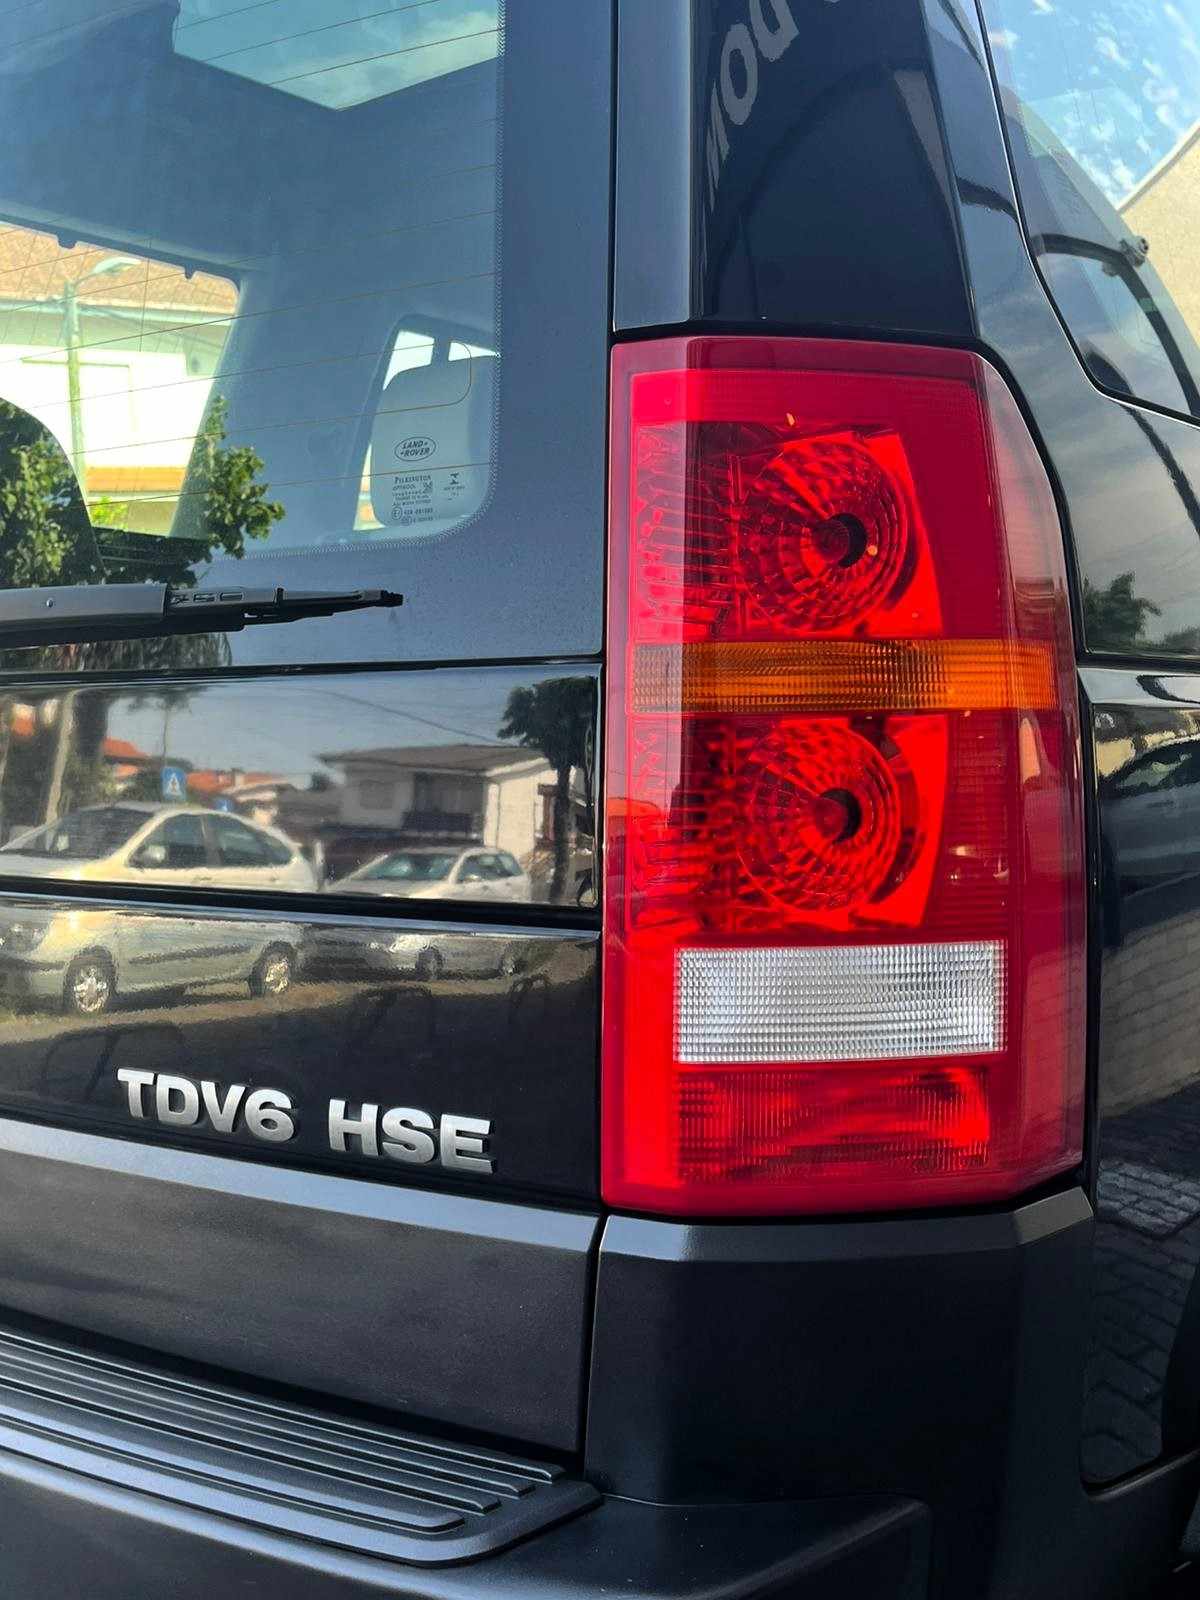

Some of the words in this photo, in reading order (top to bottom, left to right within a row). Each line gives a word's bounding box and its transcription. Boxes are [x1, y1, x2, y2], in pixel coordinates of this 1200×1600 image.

[403, 440, 424, 449] LAND
[403, 447, 430, 457] ROVER
[117, 1068, 296, 1143] TDV6
[328, 1098, 494, 1175] HSE
